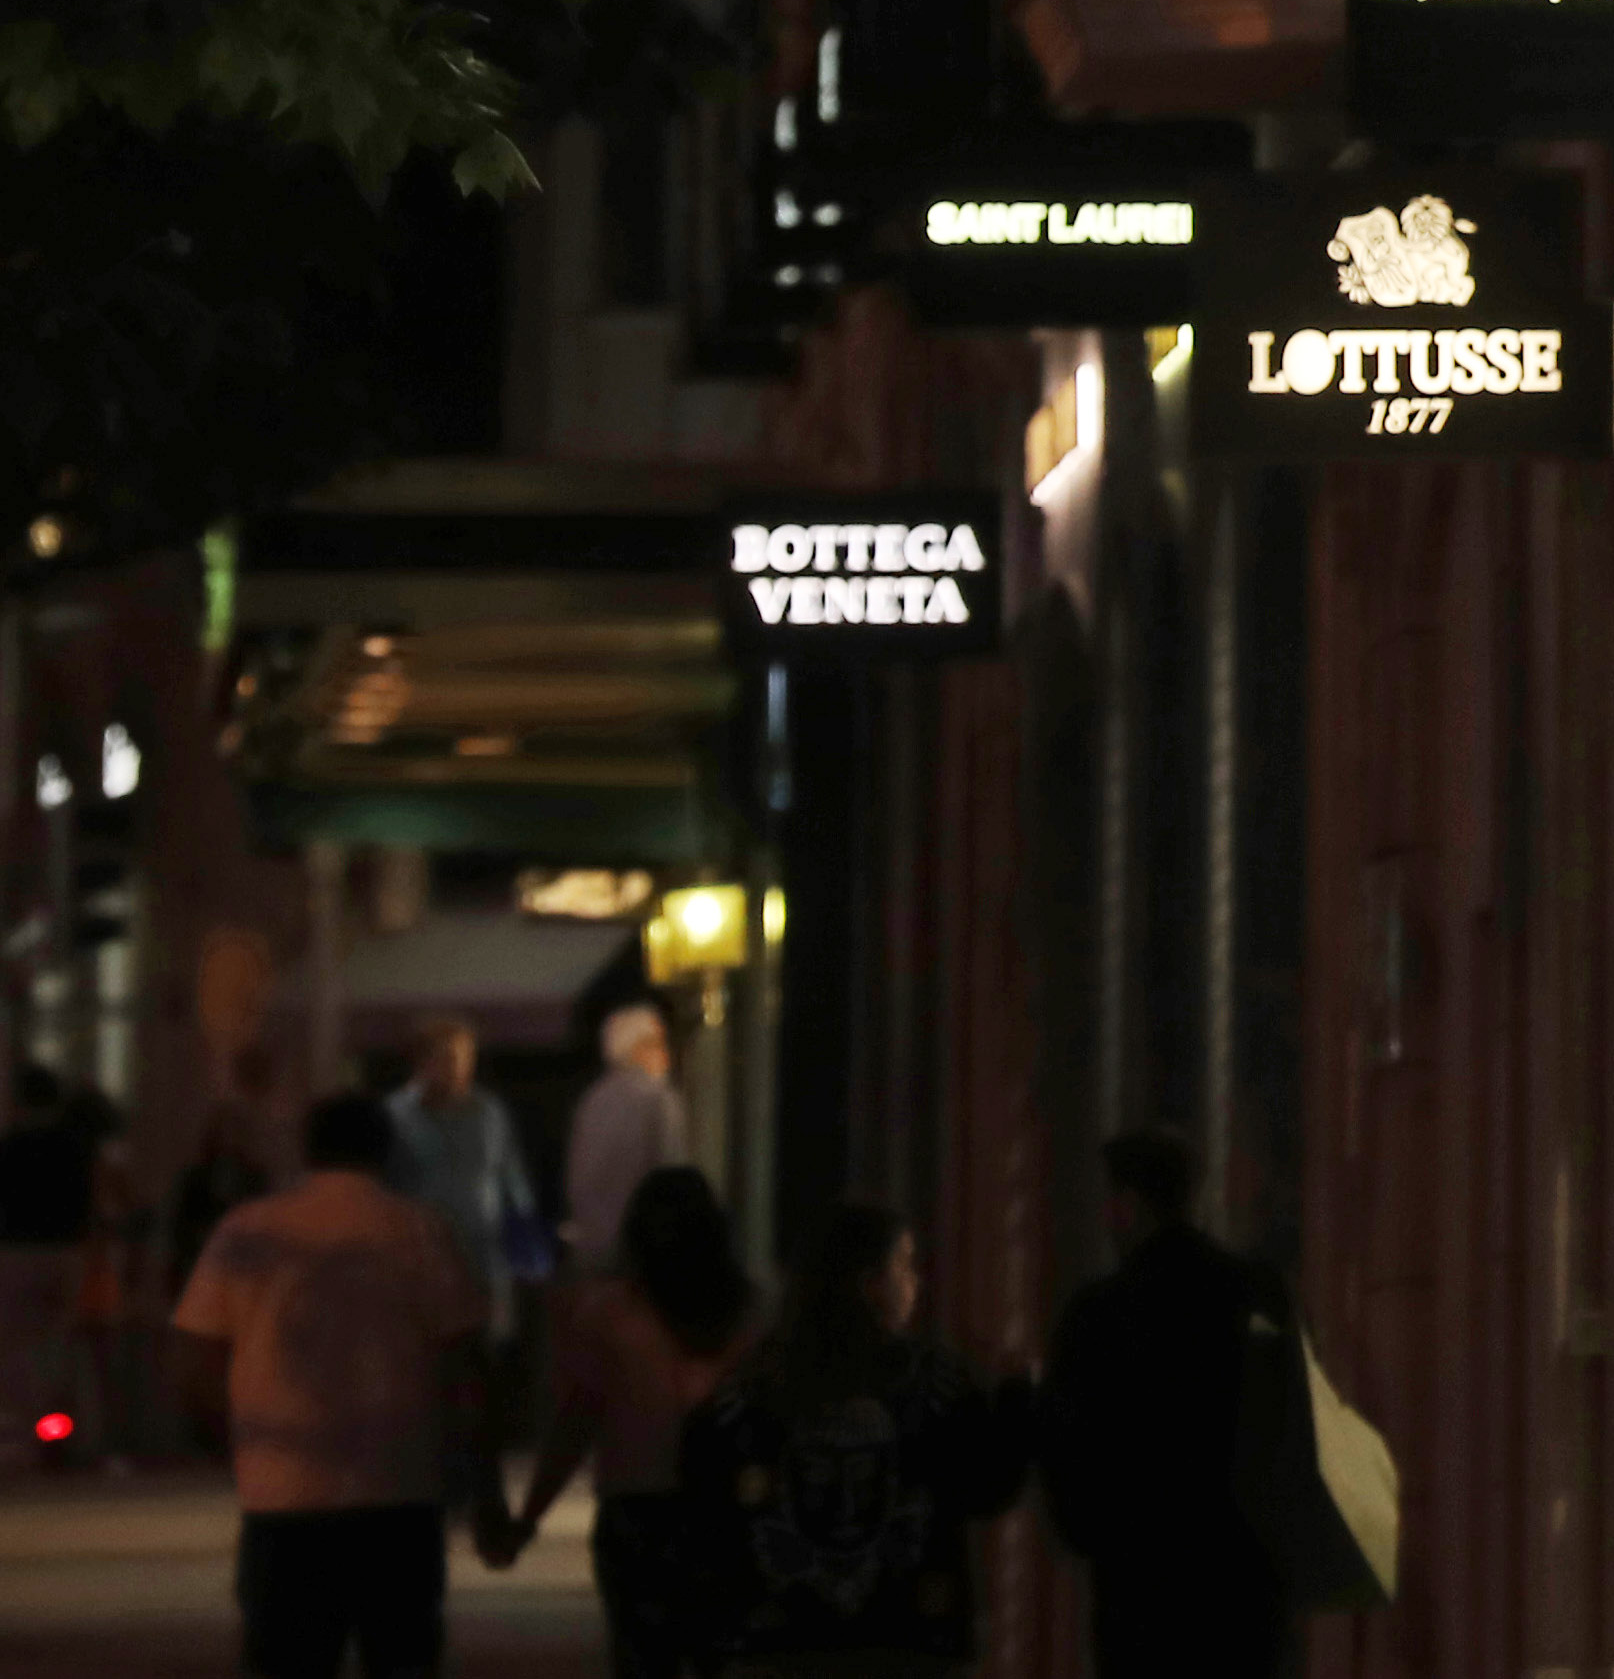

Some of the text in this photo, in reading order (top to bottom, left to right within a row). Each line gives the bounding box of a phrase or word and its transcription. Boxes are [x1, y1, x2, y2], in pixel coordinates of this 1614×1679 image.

[926, 201, 1047, 245] SAINT
[1248, 328, 1563, 395] LOTTUSSE
[1365, 397, 1454, 435] 1877
[731, 523, 985, 573] BOTTEGA
[748, 575, 970, 625] VENETA
